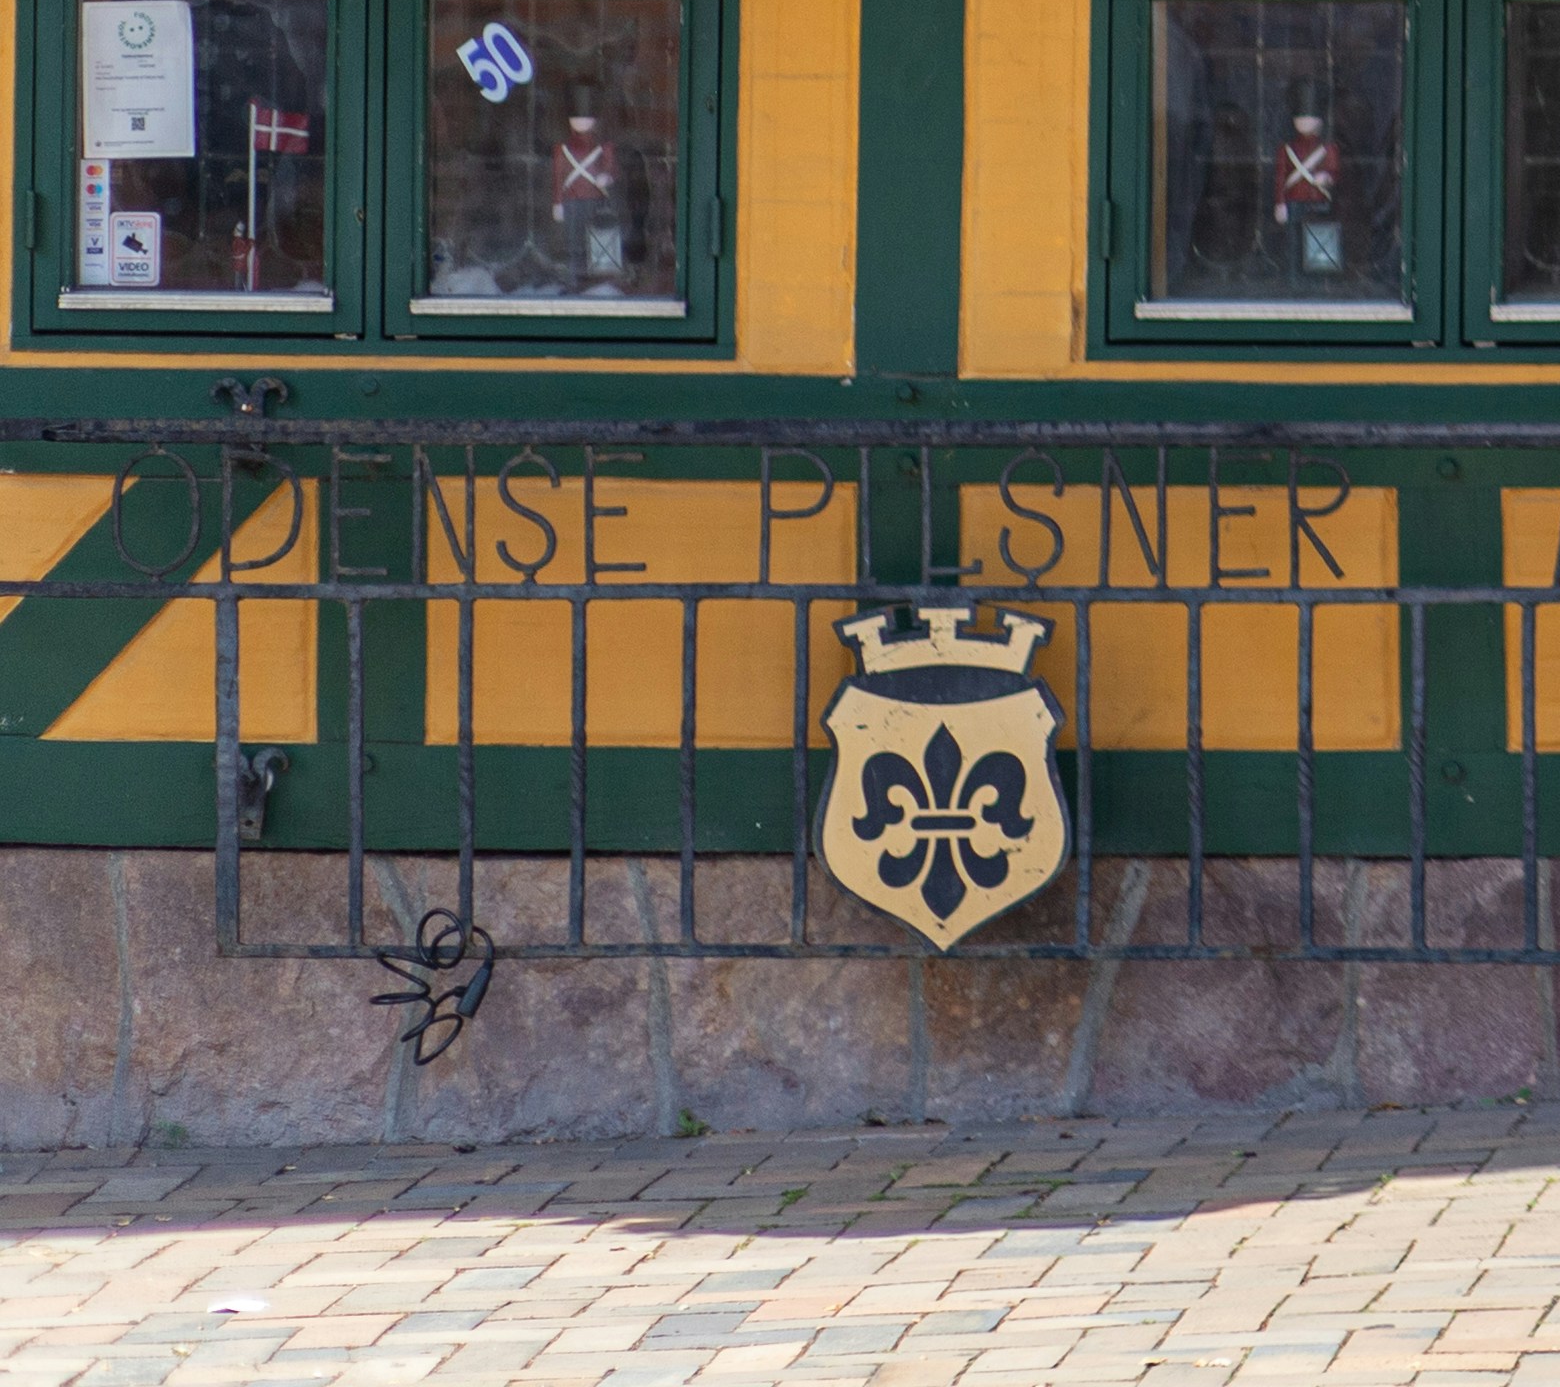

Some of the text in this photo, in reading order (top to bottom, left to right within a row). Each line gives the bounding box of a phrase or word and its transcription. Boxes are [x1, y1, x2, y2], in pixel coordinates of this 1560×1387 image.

[456, 22, 533, 103] 50
[118, 262, 149, 271] VIDEO
[112, 443, 651, 582] ODENSE
[760, 443, 1351, 587] PILSNER
